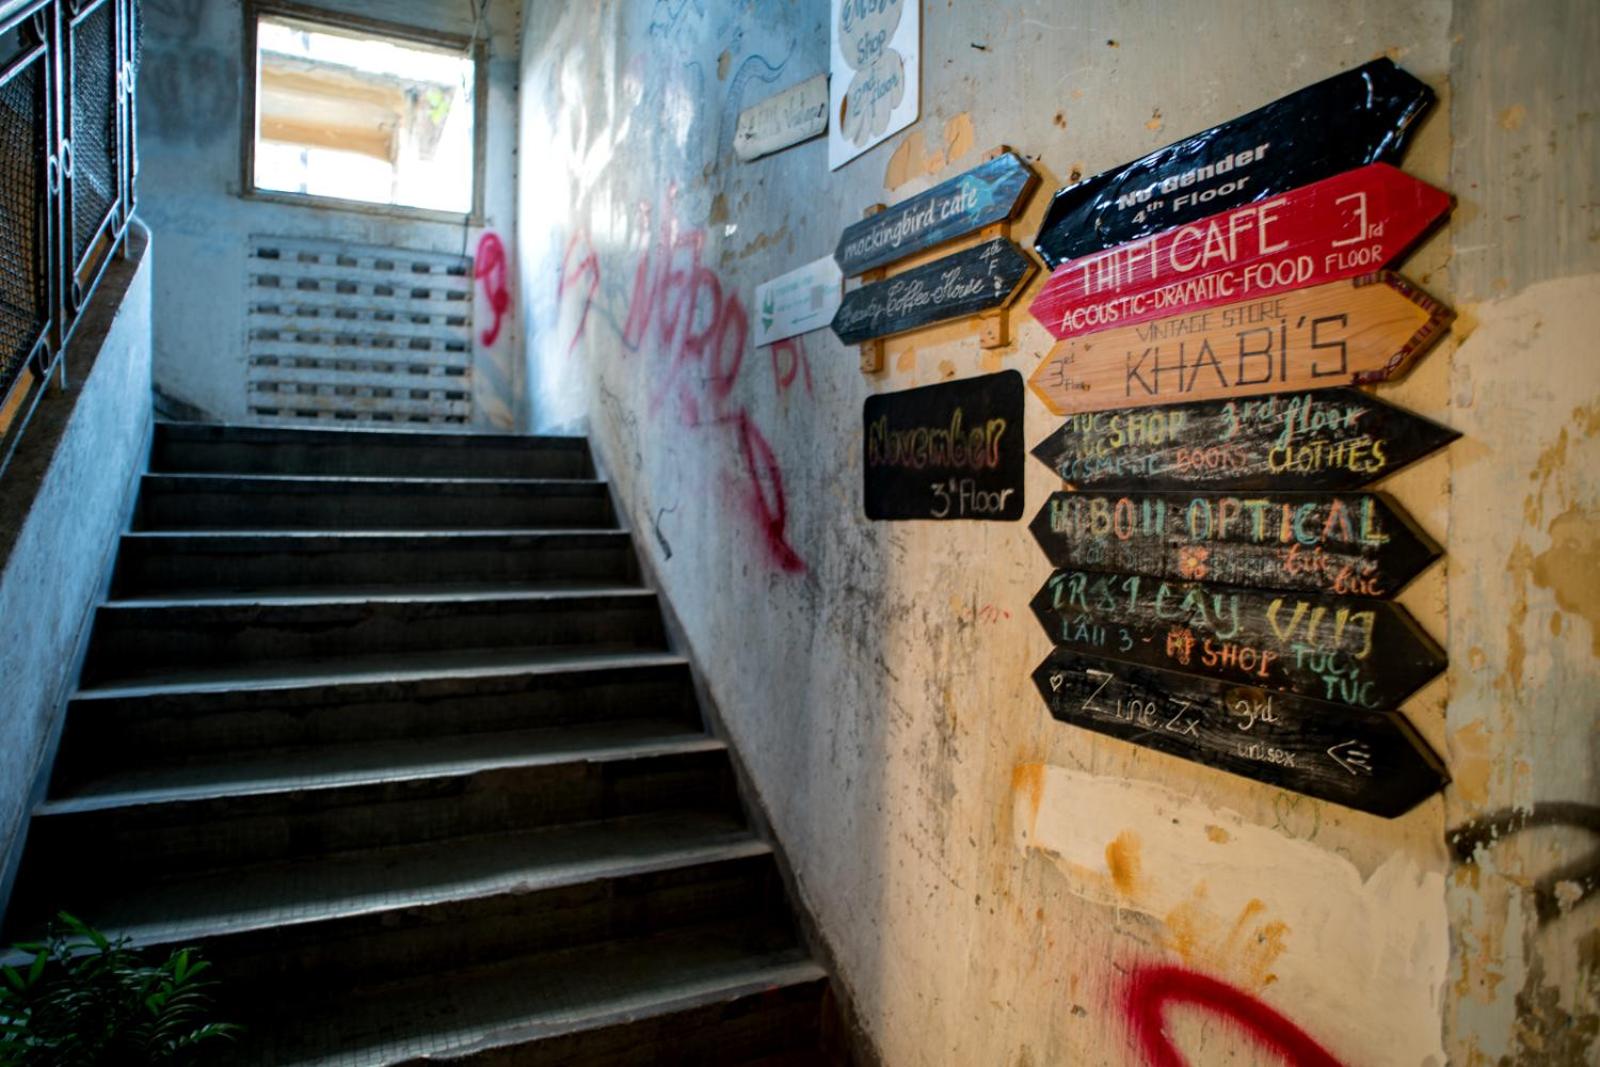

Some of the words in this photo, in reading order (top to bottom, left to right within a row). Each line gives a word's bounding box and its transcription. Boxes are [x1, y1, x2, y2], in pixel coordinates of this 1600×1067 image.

[1117, 182, 1154, 211] No
[1159, 142, 1270, 194] Gender
[1131, 199, 1165, 224] 4th
[1172, 175, 1251, 212] Floor
[844, 200, 935, 260] mockingbird
[1169, 198, 1289, 273] CAFE
[1331, 191, 1384, 248] 3rd
[1325, 245, 1383, 274] FLOOR
[1136, 307, 1213, 343] VINTAGE
[1222, 298, 1288, 330] STORE
[1109, 410, 1187, 449] SHOP
[960, 479, 1015, 516] Floor
[1186, 496, 1391, 546] OPTICAL
[1118, 628, 1134, 652] 3
[1202, 637, 1279, 677] SHOP
